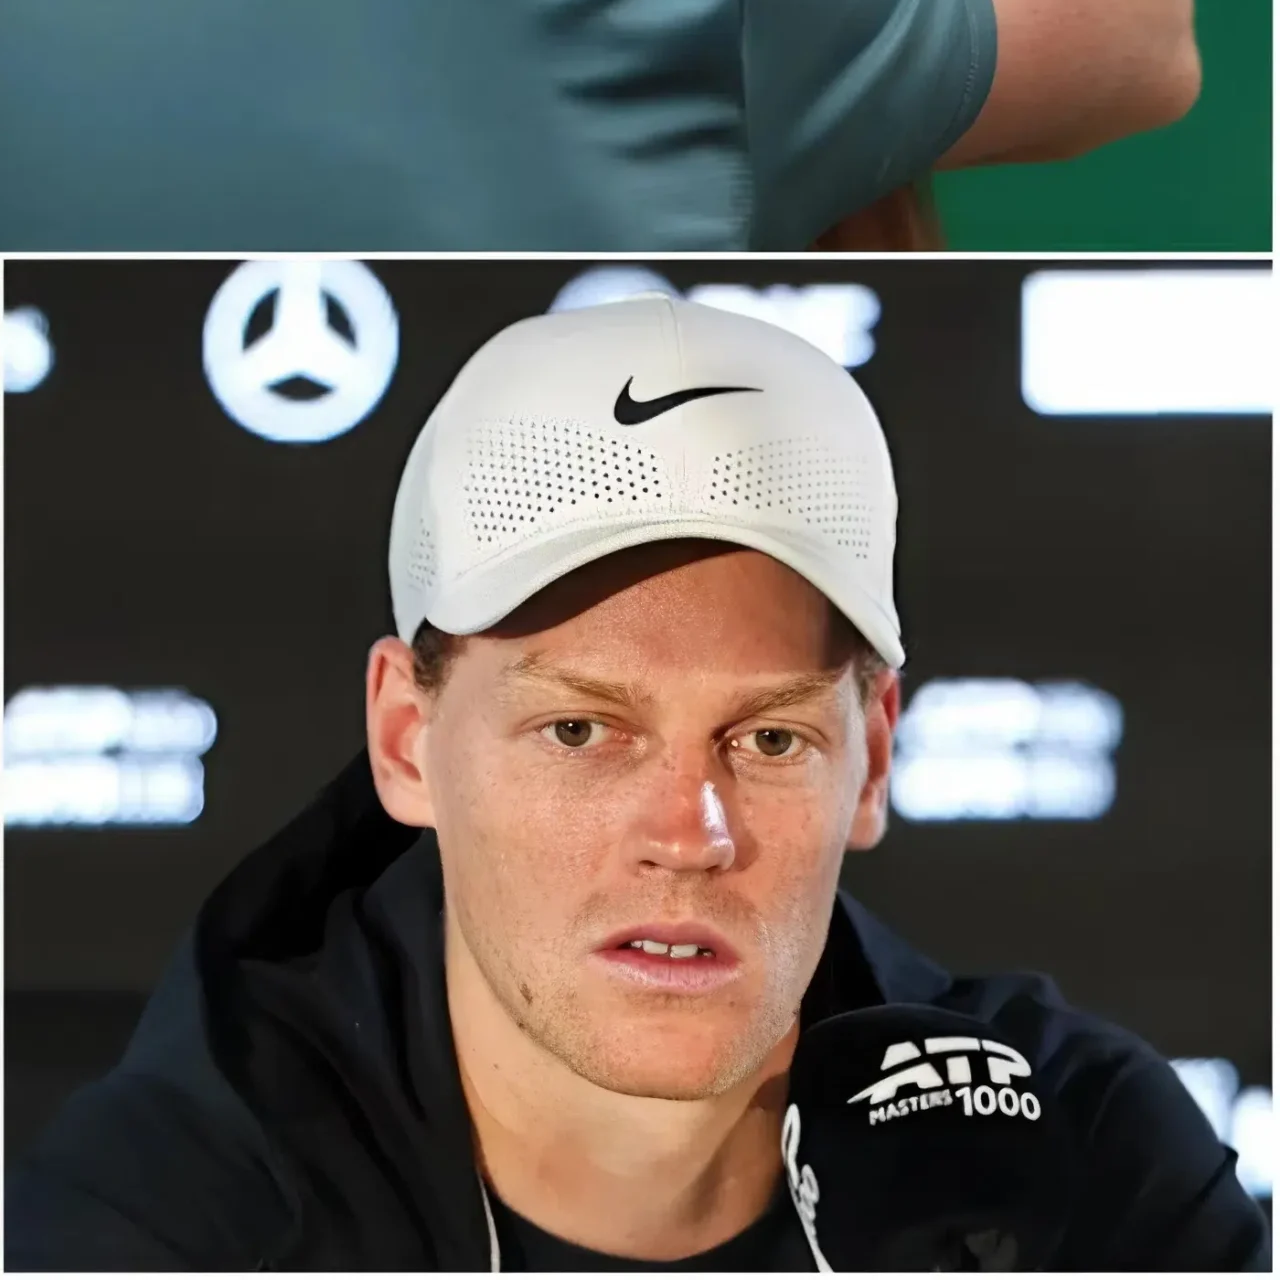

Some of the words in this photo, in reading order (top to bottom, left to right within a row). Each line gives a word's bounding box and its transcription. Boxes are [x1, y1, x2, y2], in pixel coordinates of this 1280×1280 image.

[846, 1036, 1032, 1104] ATP
[868, 1088, 953, 1125] MASTERS
[954, 1085, 1041, 1121] 1000
